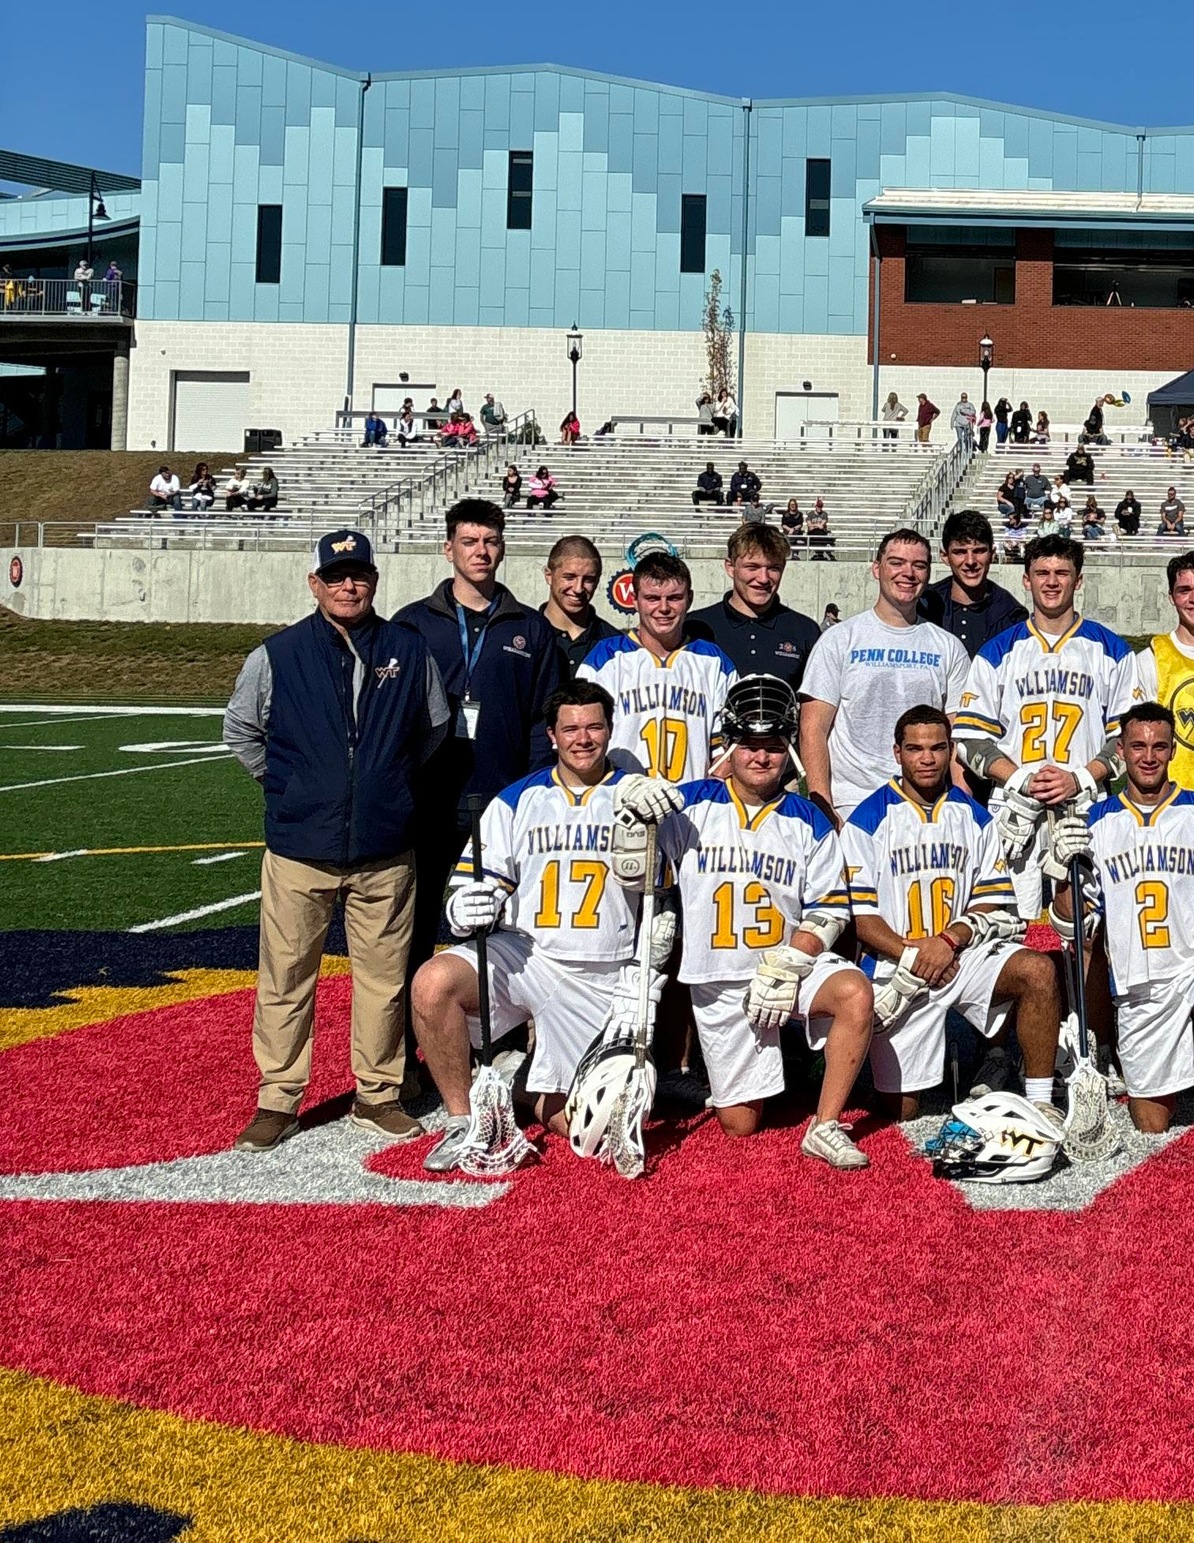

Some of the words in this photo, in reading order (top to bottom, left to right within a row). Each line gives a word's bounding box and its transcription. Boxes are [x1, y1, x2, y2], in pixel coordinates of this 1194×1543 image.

[850, 649, 886, 664] PENN
[888, 649, 942, 667] COLLEGE
[640, 717, 688, 783] 10
[1020, 701, 1084, 764] 27
[534, 860, 610, 929] 17
[711, 881, 785, 950] 13
[906, 877, 955, 940] 16
[1135, 880, 1171, 950] 2
